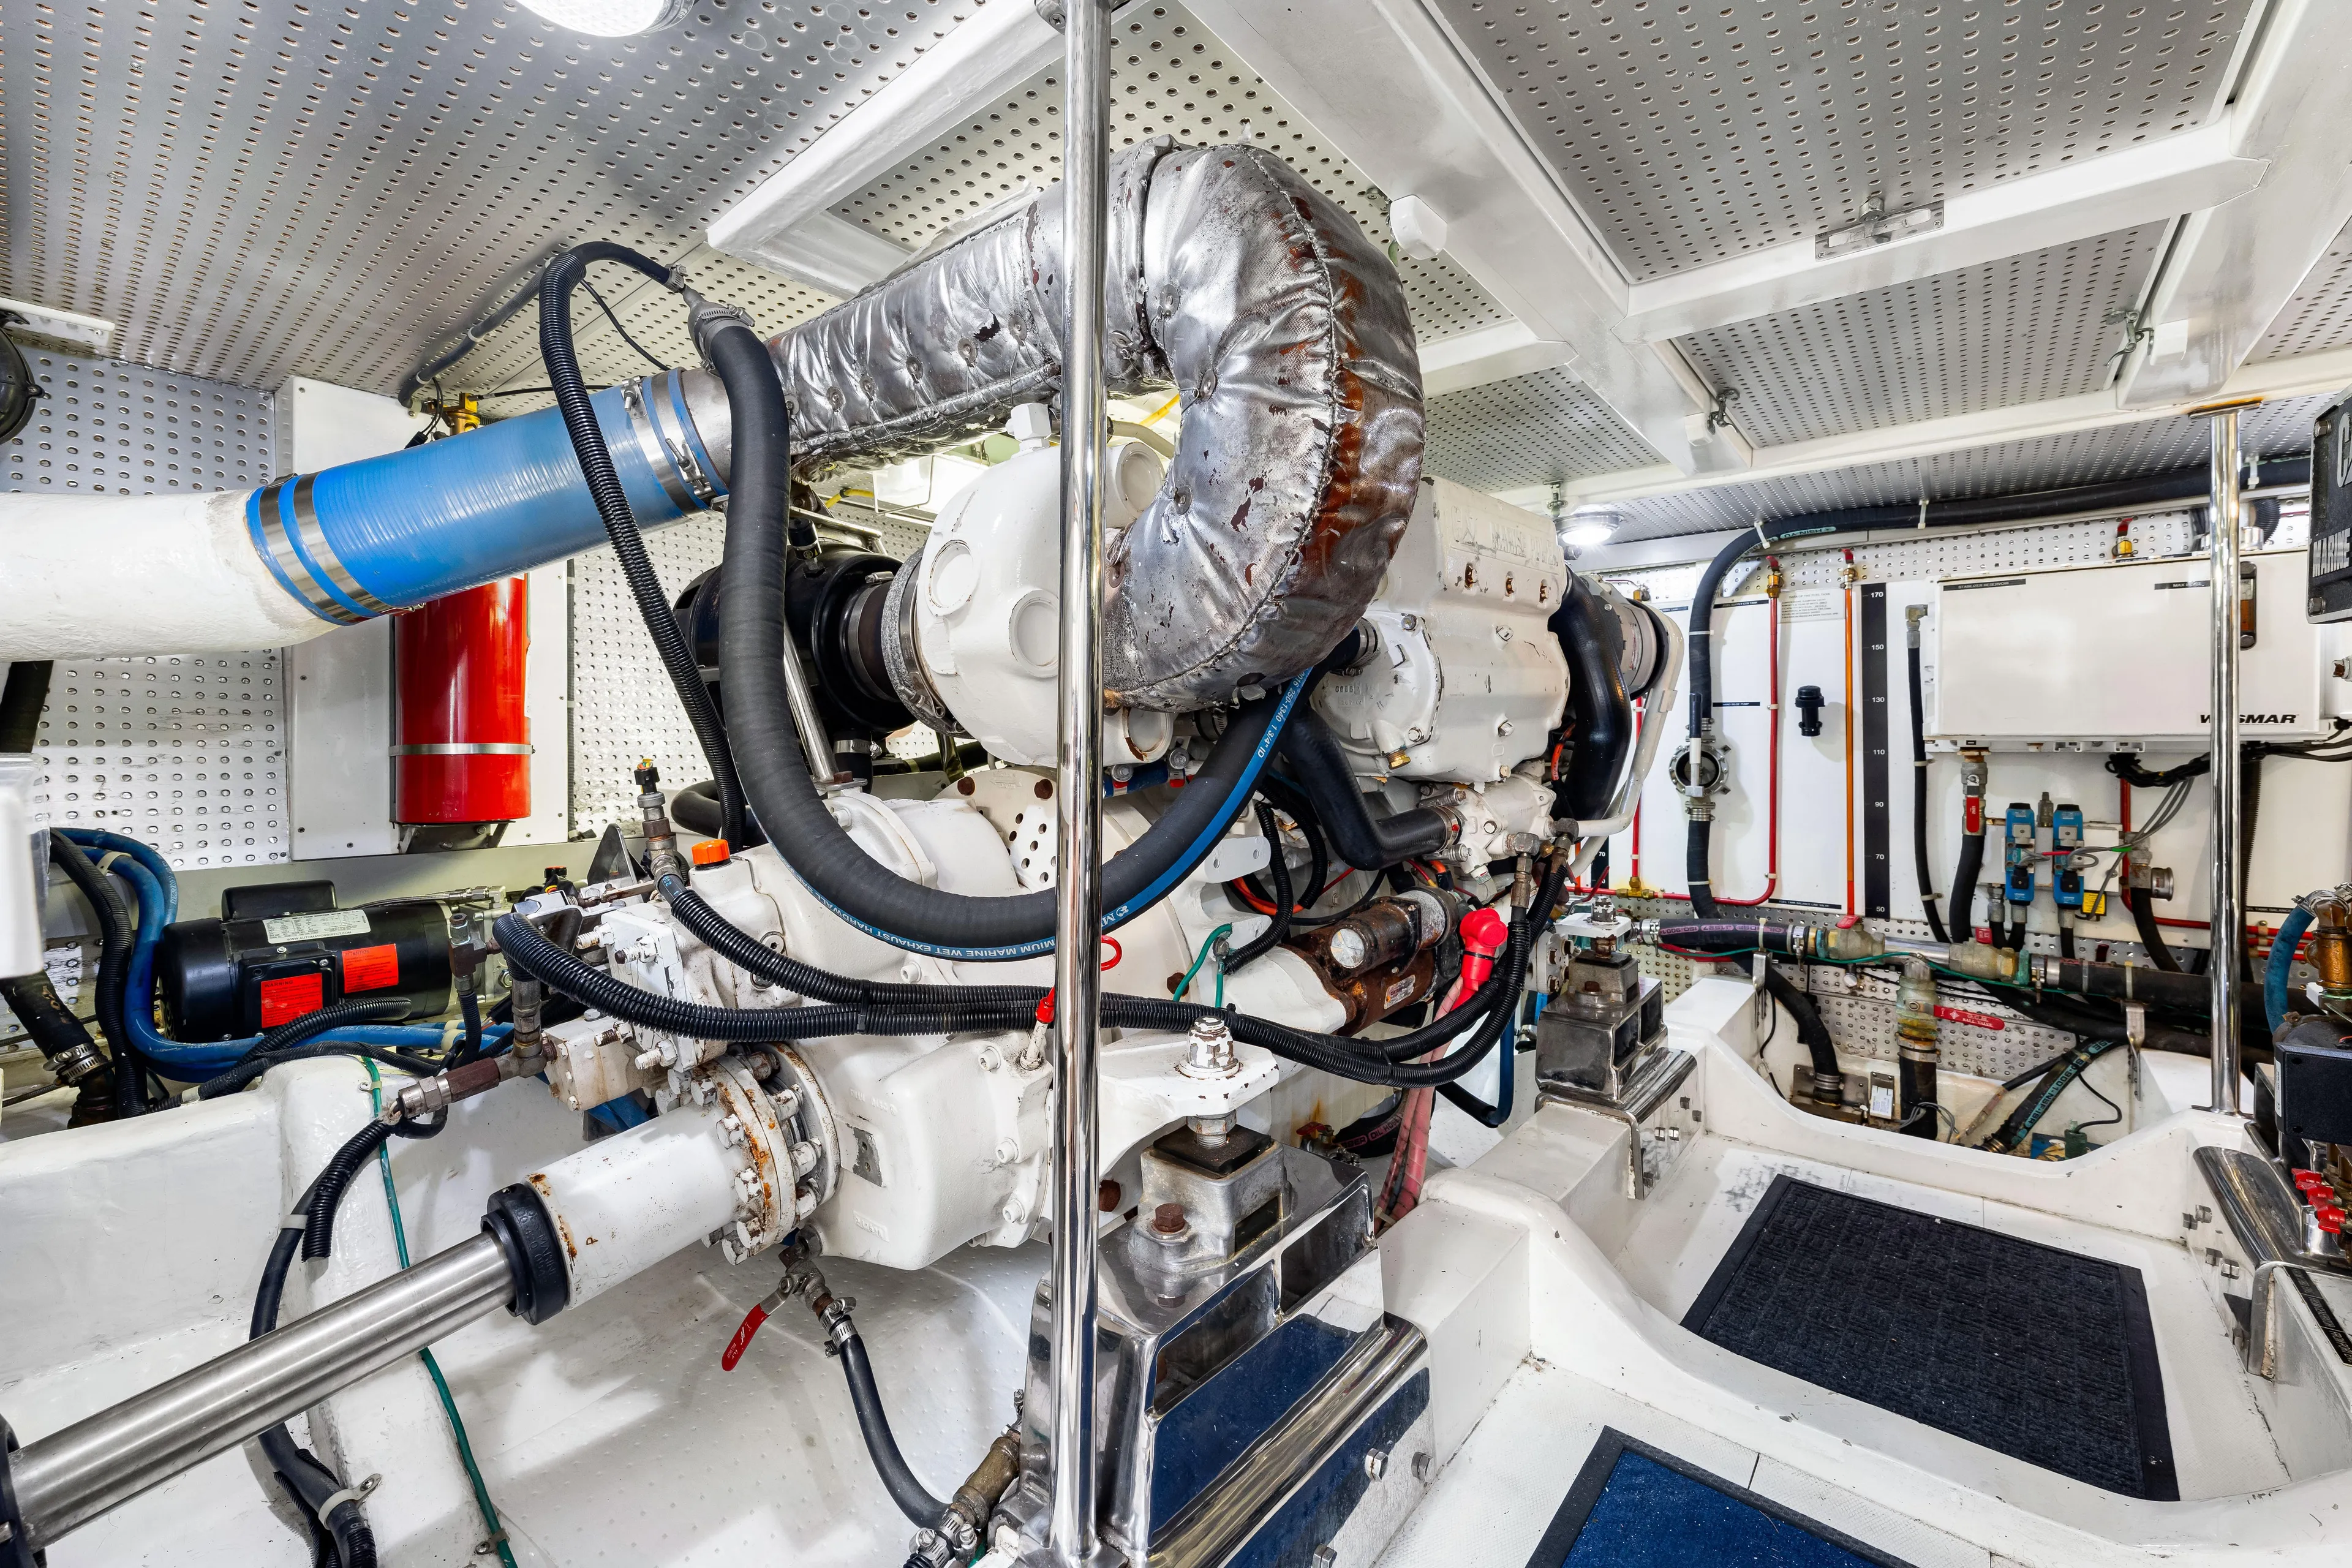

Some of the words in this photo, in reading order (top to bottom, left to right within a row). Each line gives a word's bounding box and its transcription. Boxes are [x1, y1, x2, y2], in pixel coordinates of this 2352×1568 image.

[2312, 527, 2351, 578] MARINE
[1276, 687, 1295, 722] 250-1340
[2200, 714, 2297, 723] WSMAR
[1264, 730, 1275, 748] 3/4"
[1257, 746, 1266, 758] ID
[815, 892, 873, 934] HARDWALL
[287, 930, 352, 941] WWW.AUTOMATIONDIRECT.COM
[876, 930, 932, 953] EXHAUST
[935, 946, 962, 957] WET
[966, 946, 1017, 957] MARINE
[1020, 938, 1055, 954] MIUM
[1370, 1129, 1384, 1140] OIL
